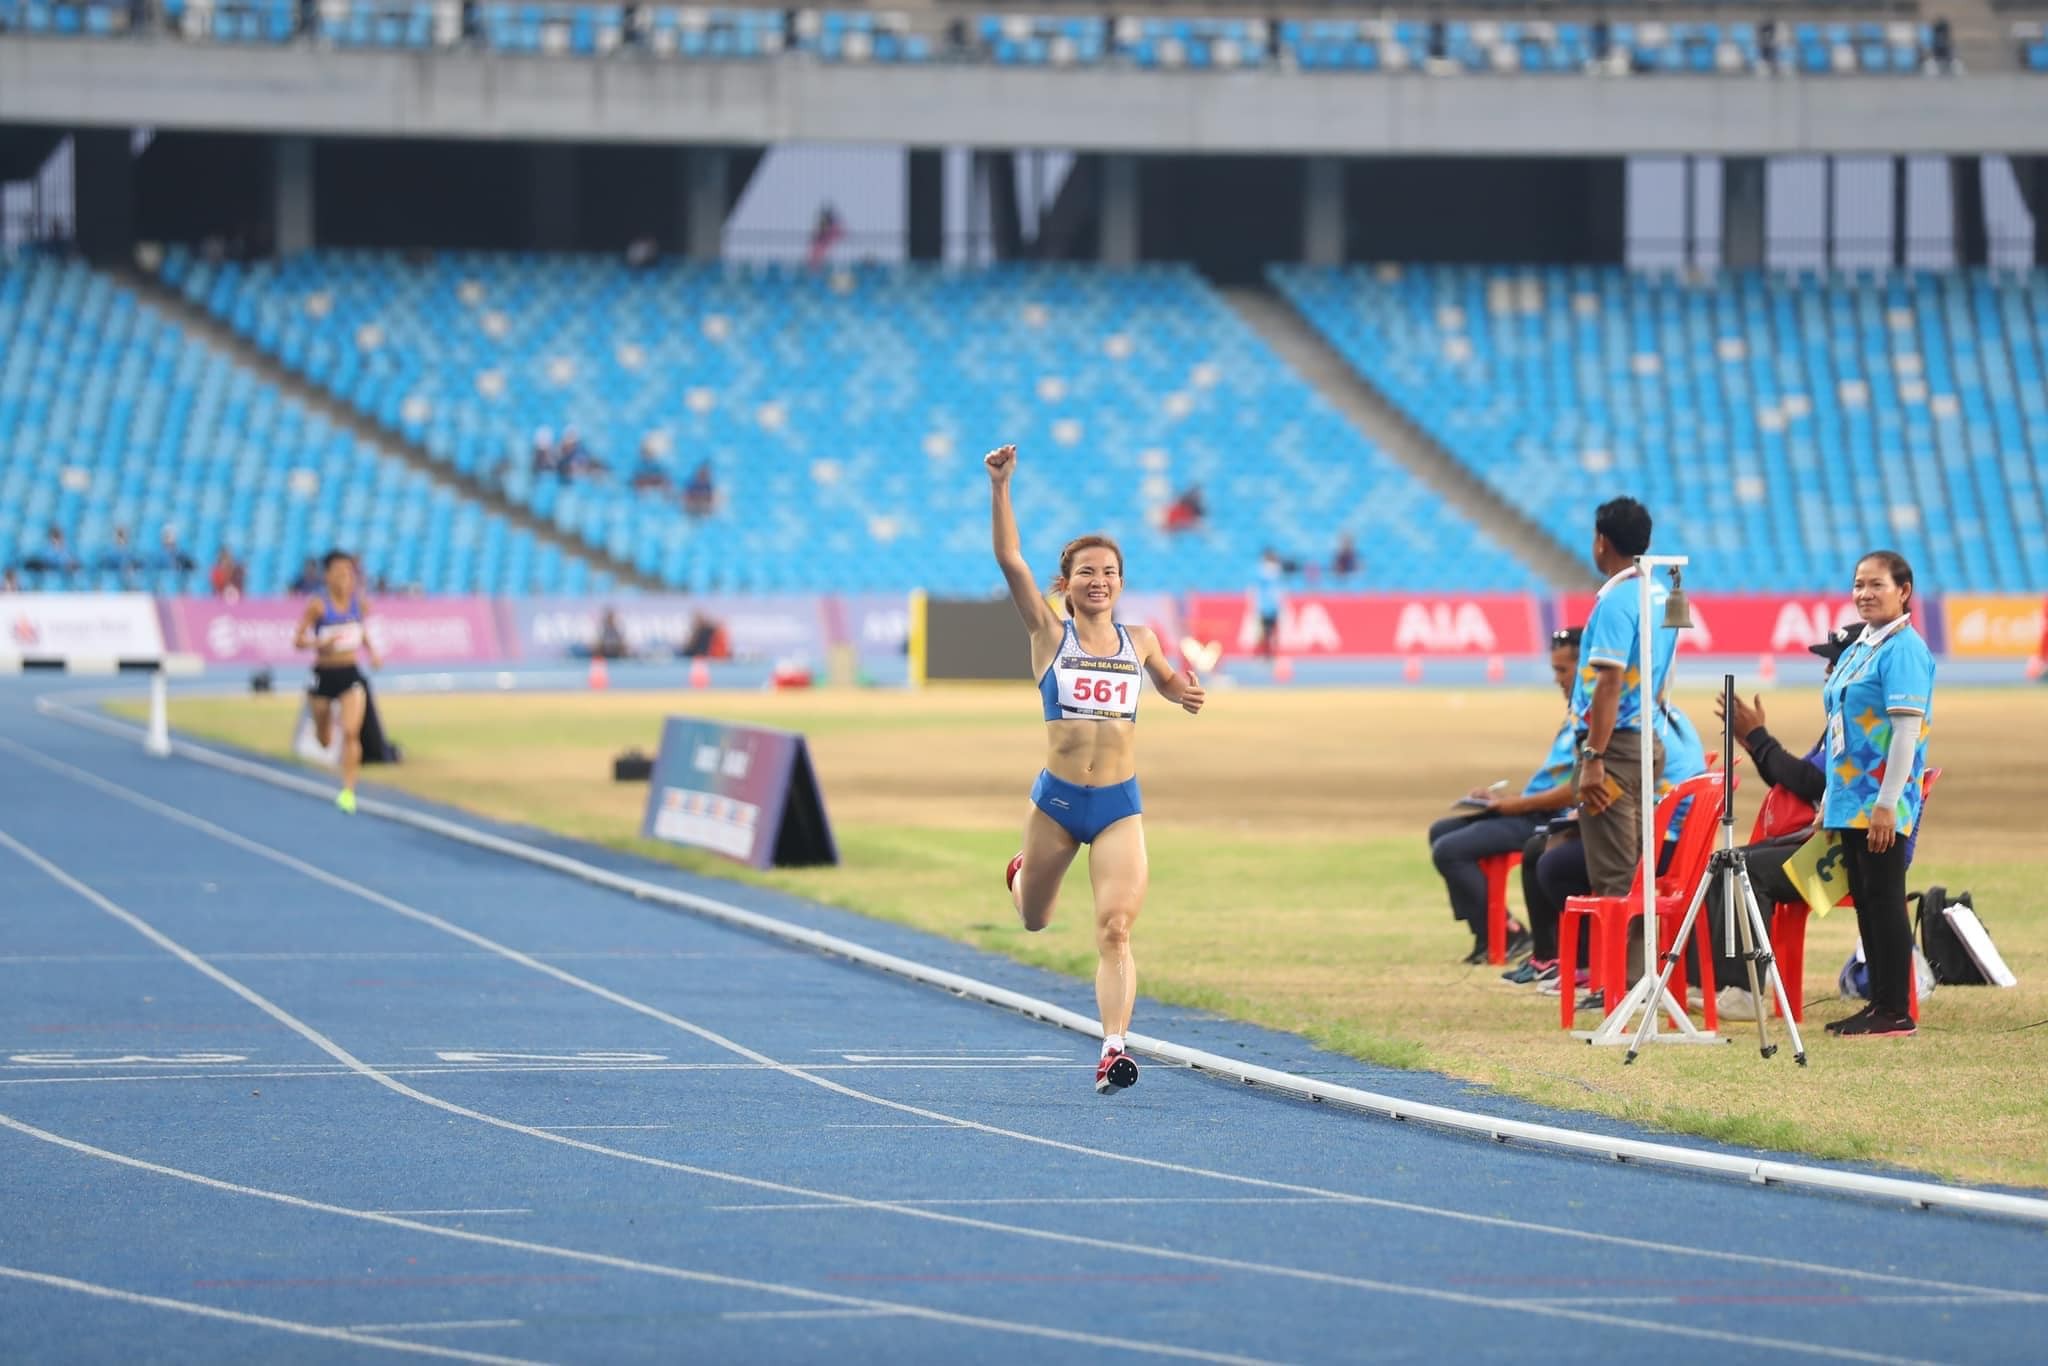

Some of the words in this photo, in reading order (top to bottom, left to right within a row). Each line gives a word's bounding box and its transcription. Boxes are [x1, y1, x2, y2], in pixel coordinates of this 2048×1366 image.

[1394, 601, 1498, 650] AIA
[1097, 661, 1112, 669] SEA
[1112, 663, 1135, 671] GAMES
[1072, 677, 1128, 705] 561
